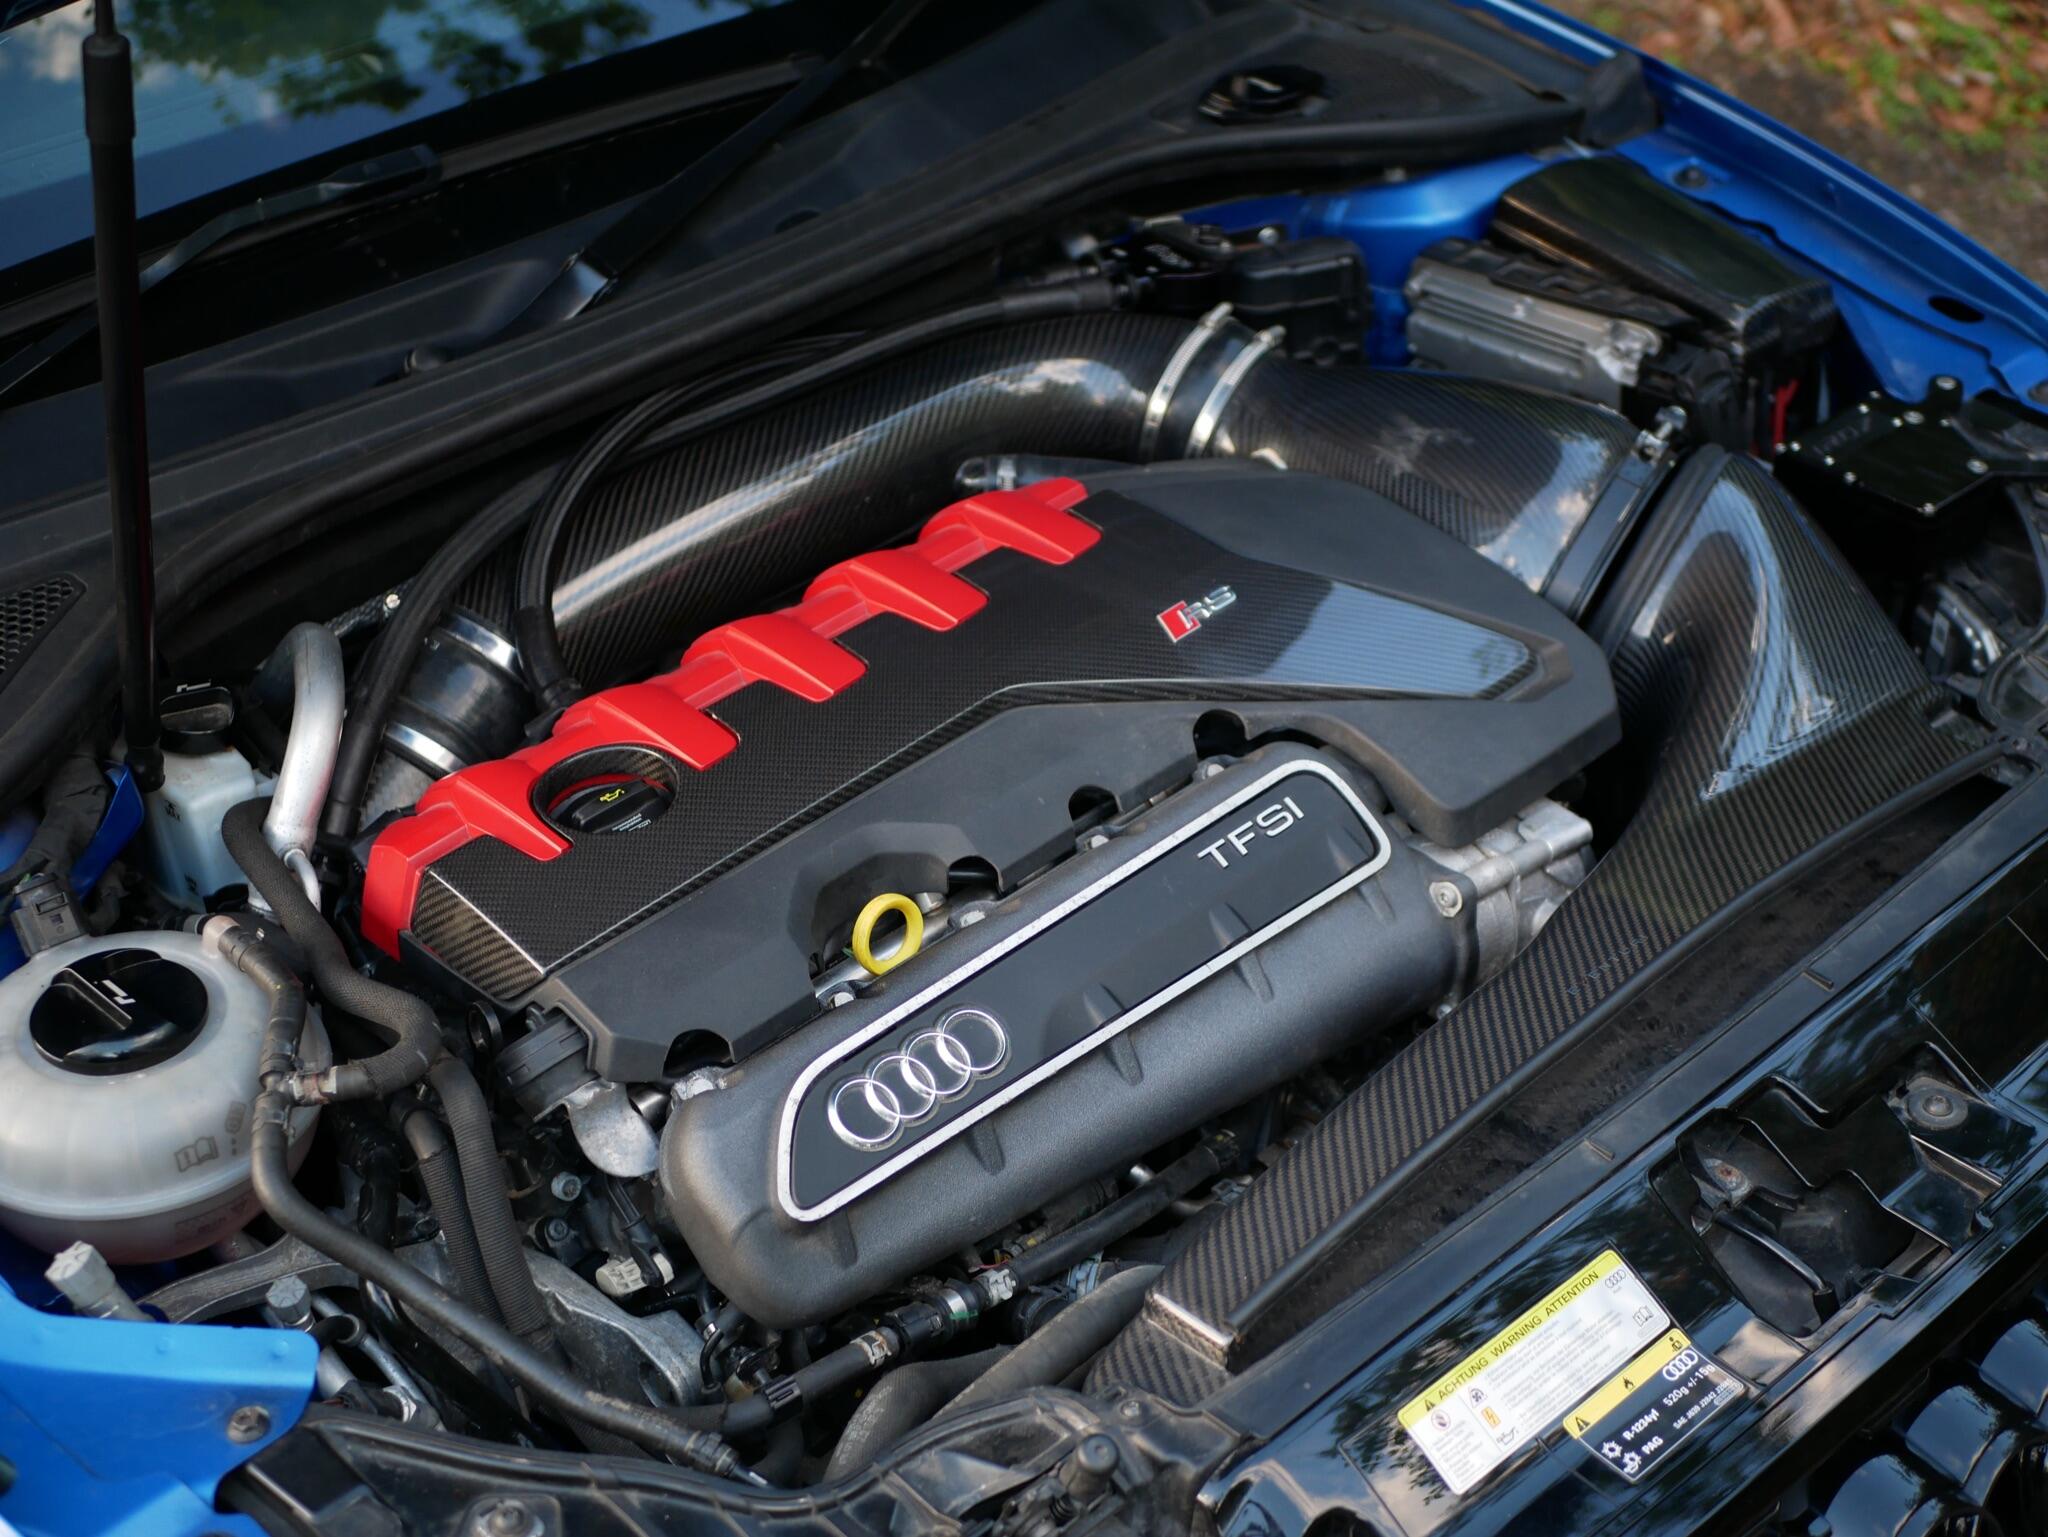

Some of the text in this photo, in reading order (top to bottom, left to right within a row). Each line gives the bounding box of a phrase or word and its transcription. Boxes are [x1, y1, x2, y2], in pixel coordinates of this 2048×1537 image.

[1176, 585, 1237, 629] RS
[1197, 796, 1305, 868] TFSI
[1438, 1271, 1599, 1400] ACHTUNG WARNING ATTENTION
[1663, 1386, 1690, 1406] 520g
[1641, 1435, 1664, 1455] PAG
[1673, 1415, 1688, 1429] SAE
